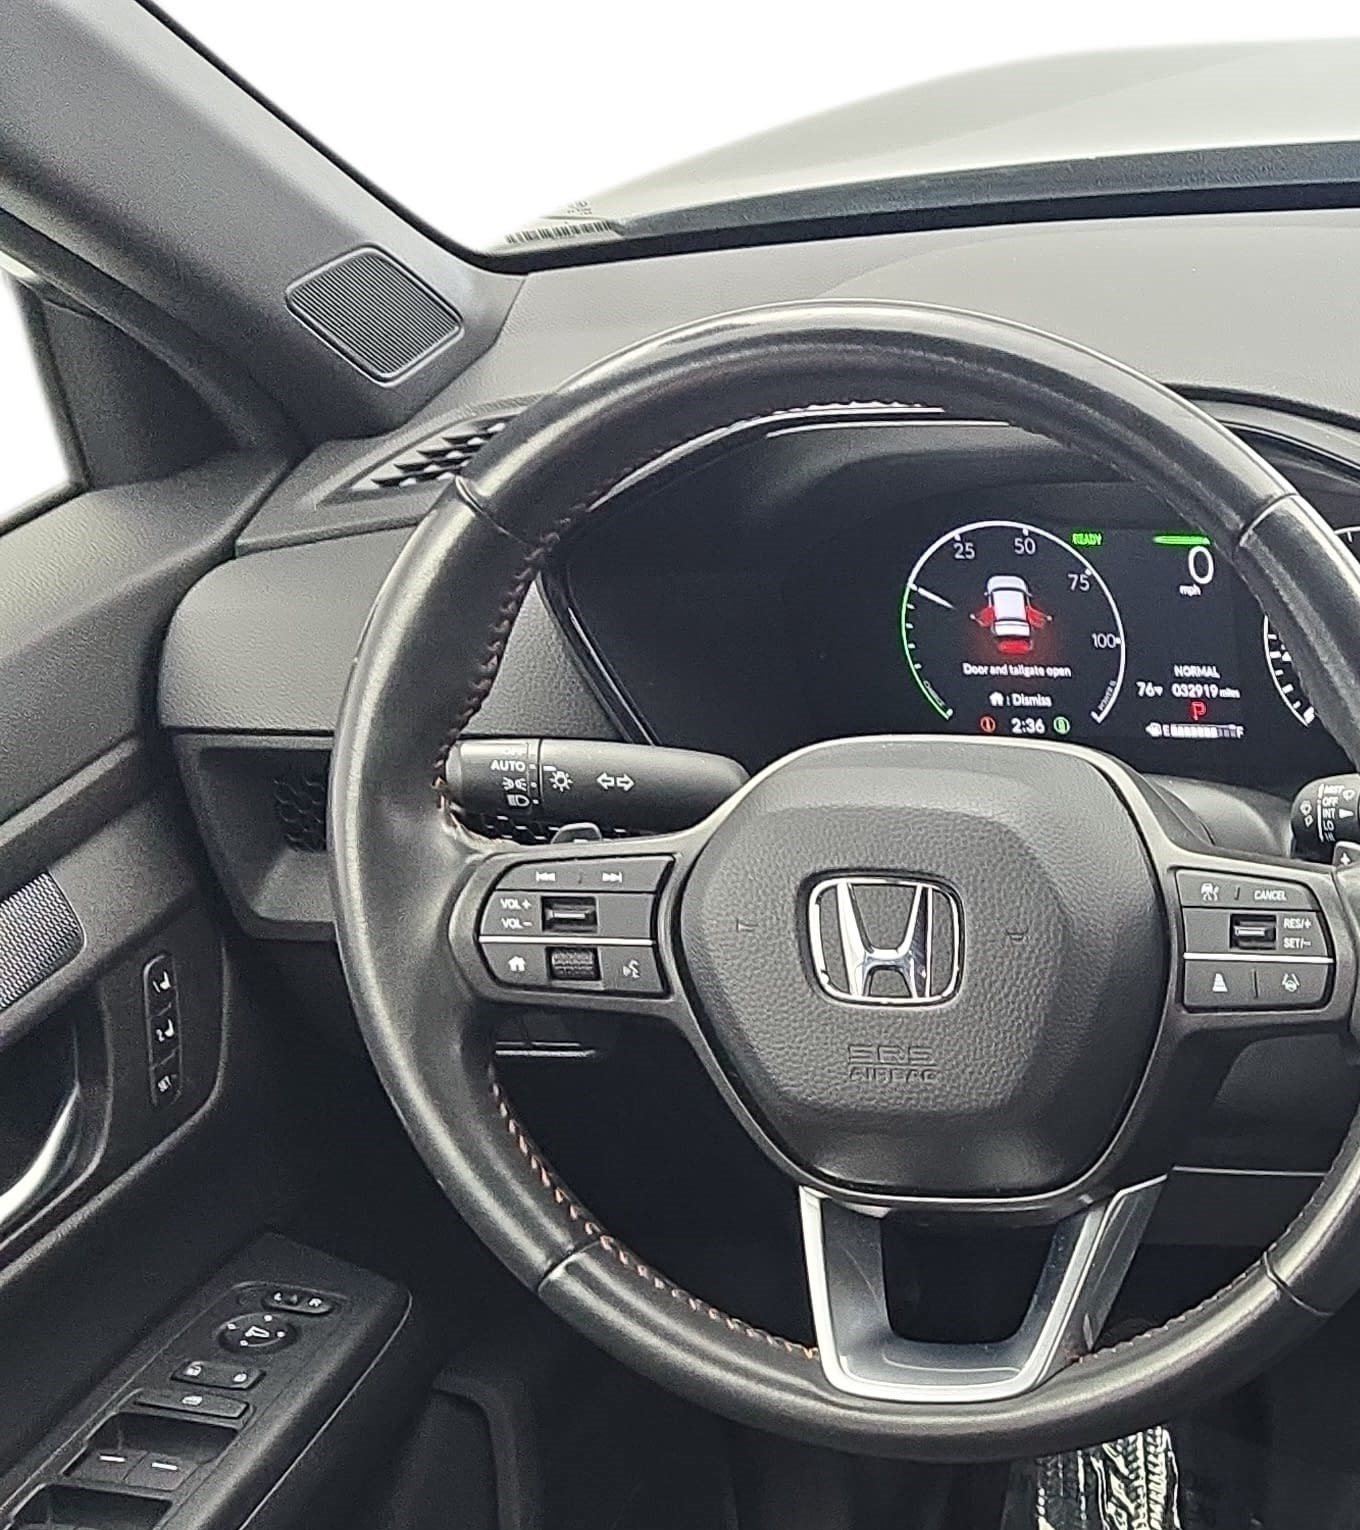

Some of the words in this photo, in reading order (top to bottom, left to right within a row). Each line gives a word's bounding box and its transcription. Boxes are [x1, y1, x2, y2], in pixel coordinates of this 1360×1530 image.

[953, 542, 976, 560] 25
[1013, 538, 1036, 555] 50
[1187, 545, 1214, 585] 0
[1067, 573, 1091, 591] 75
[1091, 633, 1117, 649] 100
[962, 662, 988, 676] Door
[990, 663, 1008, 676] and
[1009, 663, 1046, 678] tailgate
[1047, 666, 1073, 679] open
[1173, 664, 1221, 679] NORMAL
[1171, 682, 1219, 698] 032919
[1012, 693, 1052, 707] Dismiss
[1191, 701, 1208, 721] P
[1011, 718, 1046, 734] 2:36
[490, 759, 526, 773] AUTO
[1322, 796, 1339, 807] OFF
[1322, 807, 1336, 820] INT
[1322, 820, 1335, 832] LO
[1253, 888, 1288, 902] CANCEL
